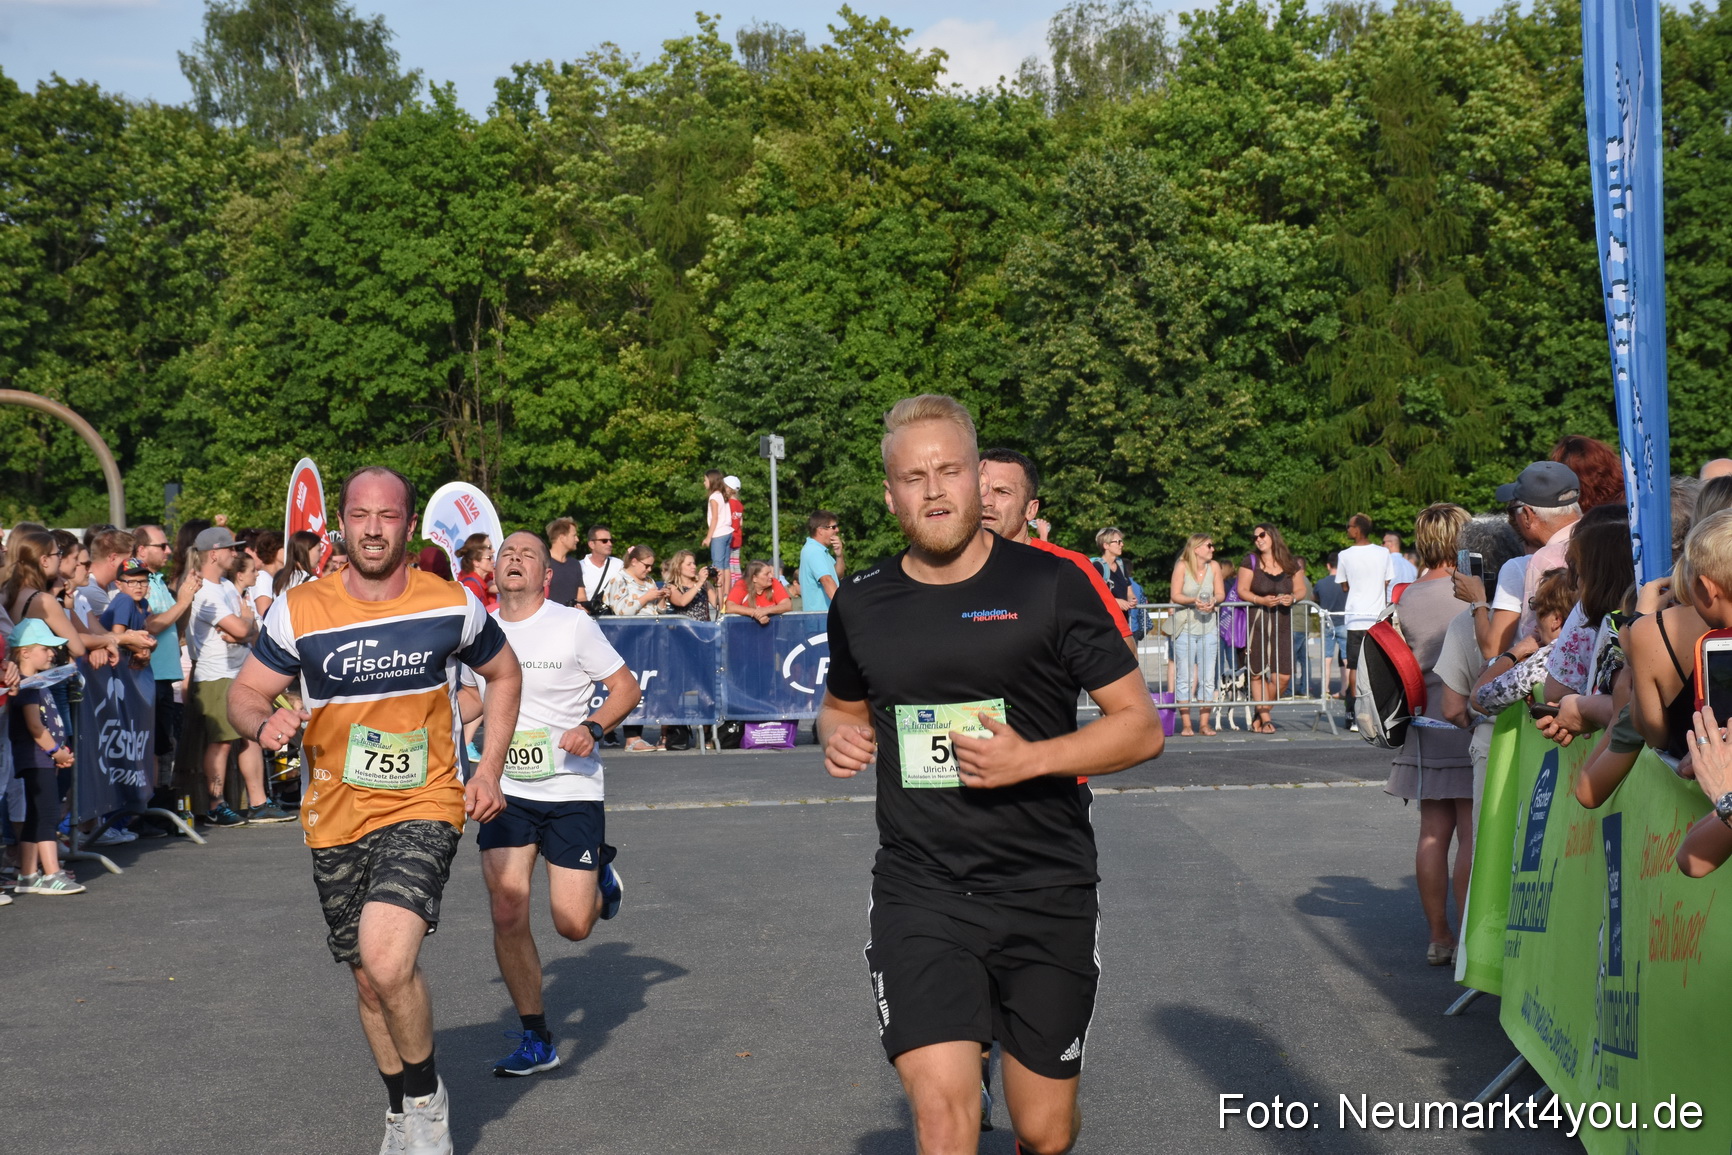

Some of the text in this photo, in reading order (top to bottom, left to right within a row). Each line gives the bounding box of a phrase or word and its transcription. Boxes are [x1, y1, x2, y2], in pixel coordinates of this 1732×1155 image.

[862, 569, 880, 580] JAKO
[961, 608, 1007, 618] autoladen
[973, 612, 1018, 621] neumarkt
[343, 650, 433, 675] Fischer
[520, 661, 562, 669] HOLZBAU
[352, 666, 425, 683] AUTOMOBILE
[912, 720, 951, 729] firmenlauf
[932, 735, 958, 763] 5
[505, 747, 543, 765] 090
[364, 750, 410, 773] 753
[355, 769, 388, 779] Heiselbetz
[923, 765, 947, 773] Ulrich
